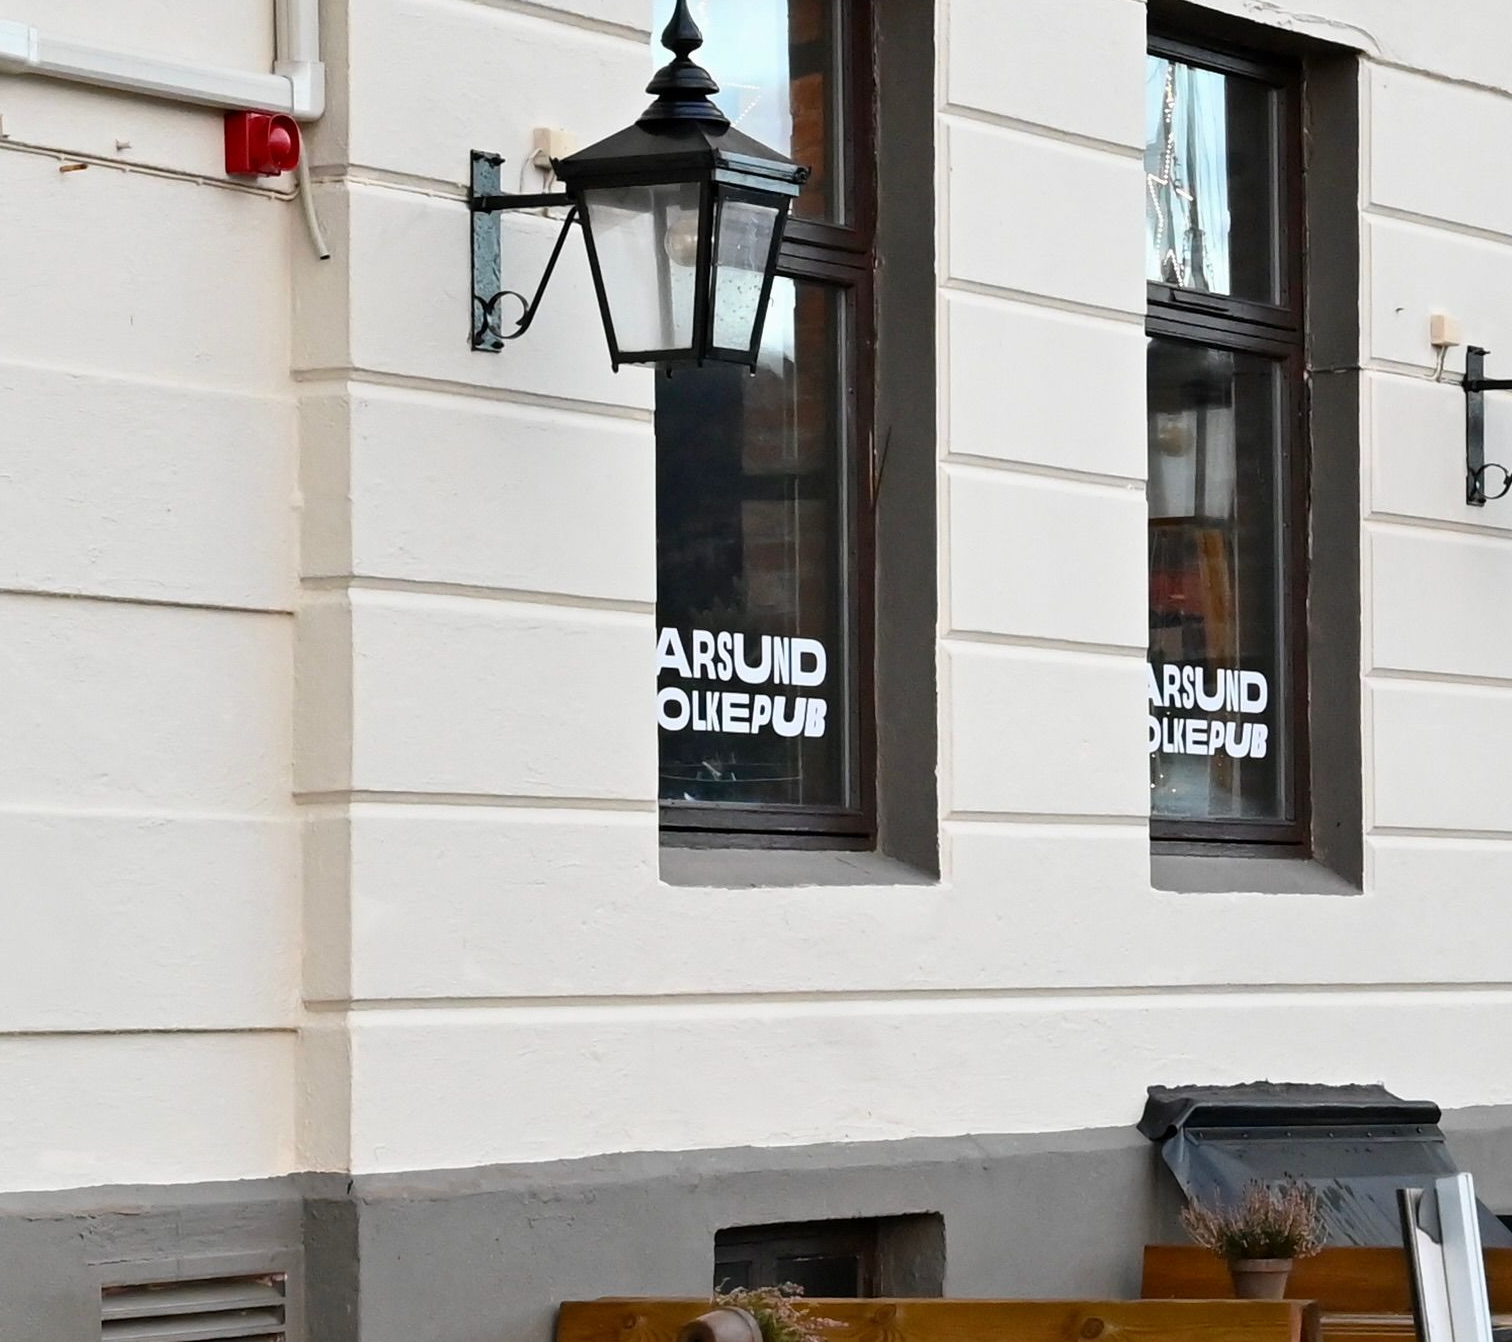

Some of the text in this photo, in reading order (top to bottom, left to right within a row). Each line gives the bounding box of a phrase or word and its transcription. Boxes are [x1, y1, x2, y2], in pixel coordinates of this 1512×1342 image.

[656, 627, 827, 687] ARSUND
[657, 686, 828, 738] OLKEPUB
[1146, 662, 1268, 714] ARSUND
[1147, 715, 1269, 759] OLKEPUB
